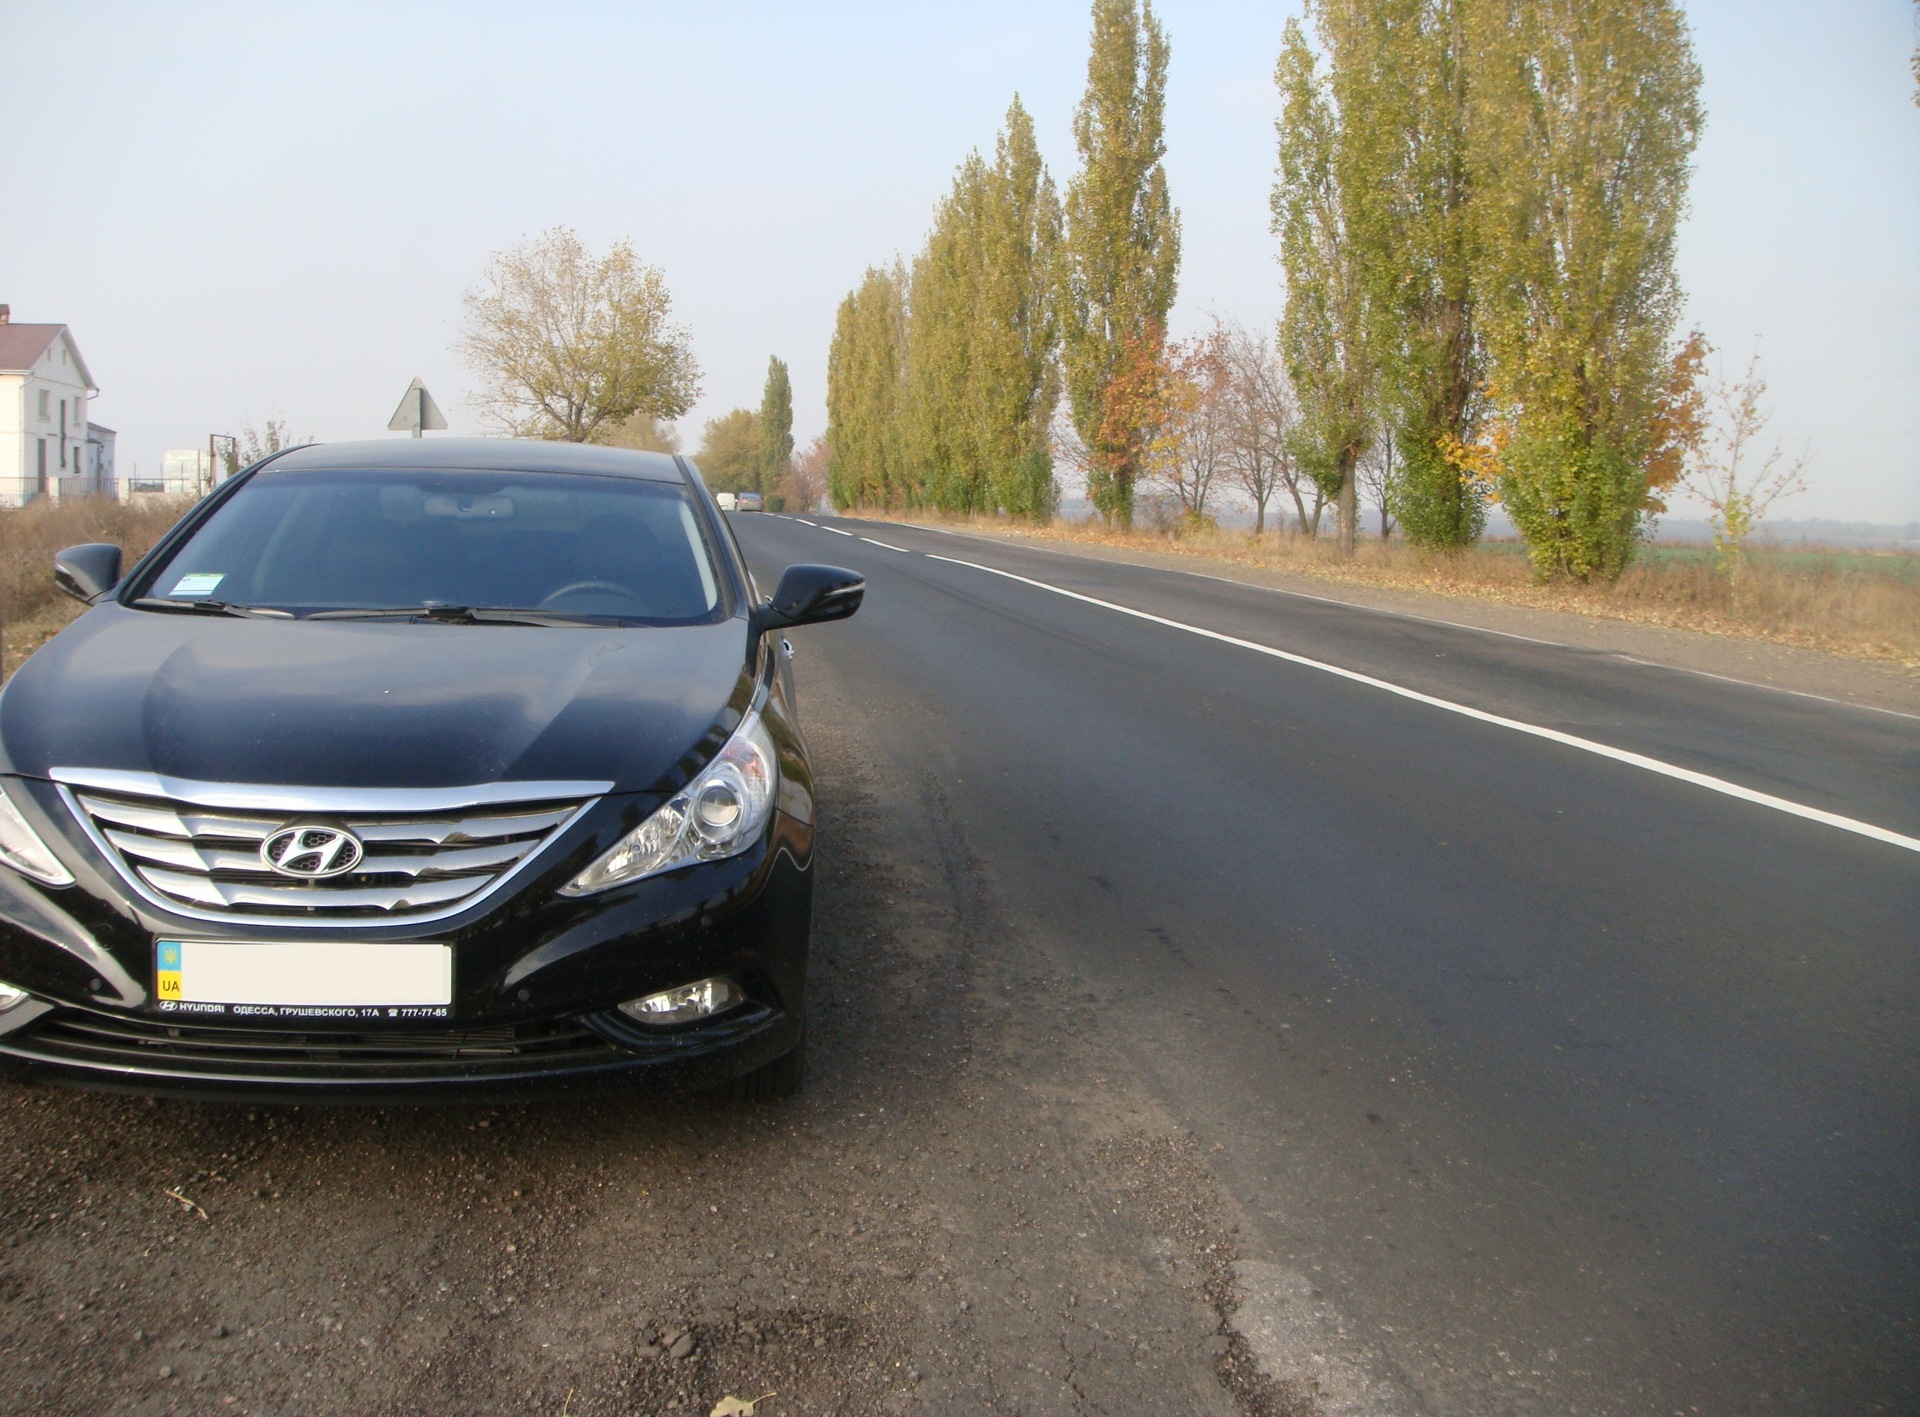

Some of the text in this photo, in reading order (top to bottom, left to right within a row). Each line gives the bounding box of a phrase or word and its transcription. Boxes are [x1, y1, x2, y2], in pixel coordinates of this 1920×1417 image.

[162, 980, 180, 992] UA
[179, 1002, 225, 1013] HYUNDAI
[233, 1005, 278, 1016] ОДЕССА,
[280, 1007, 359, 1018] ГРУШЕВСКОГО,
[401, 1008, 447, 1017] 777-77-85
